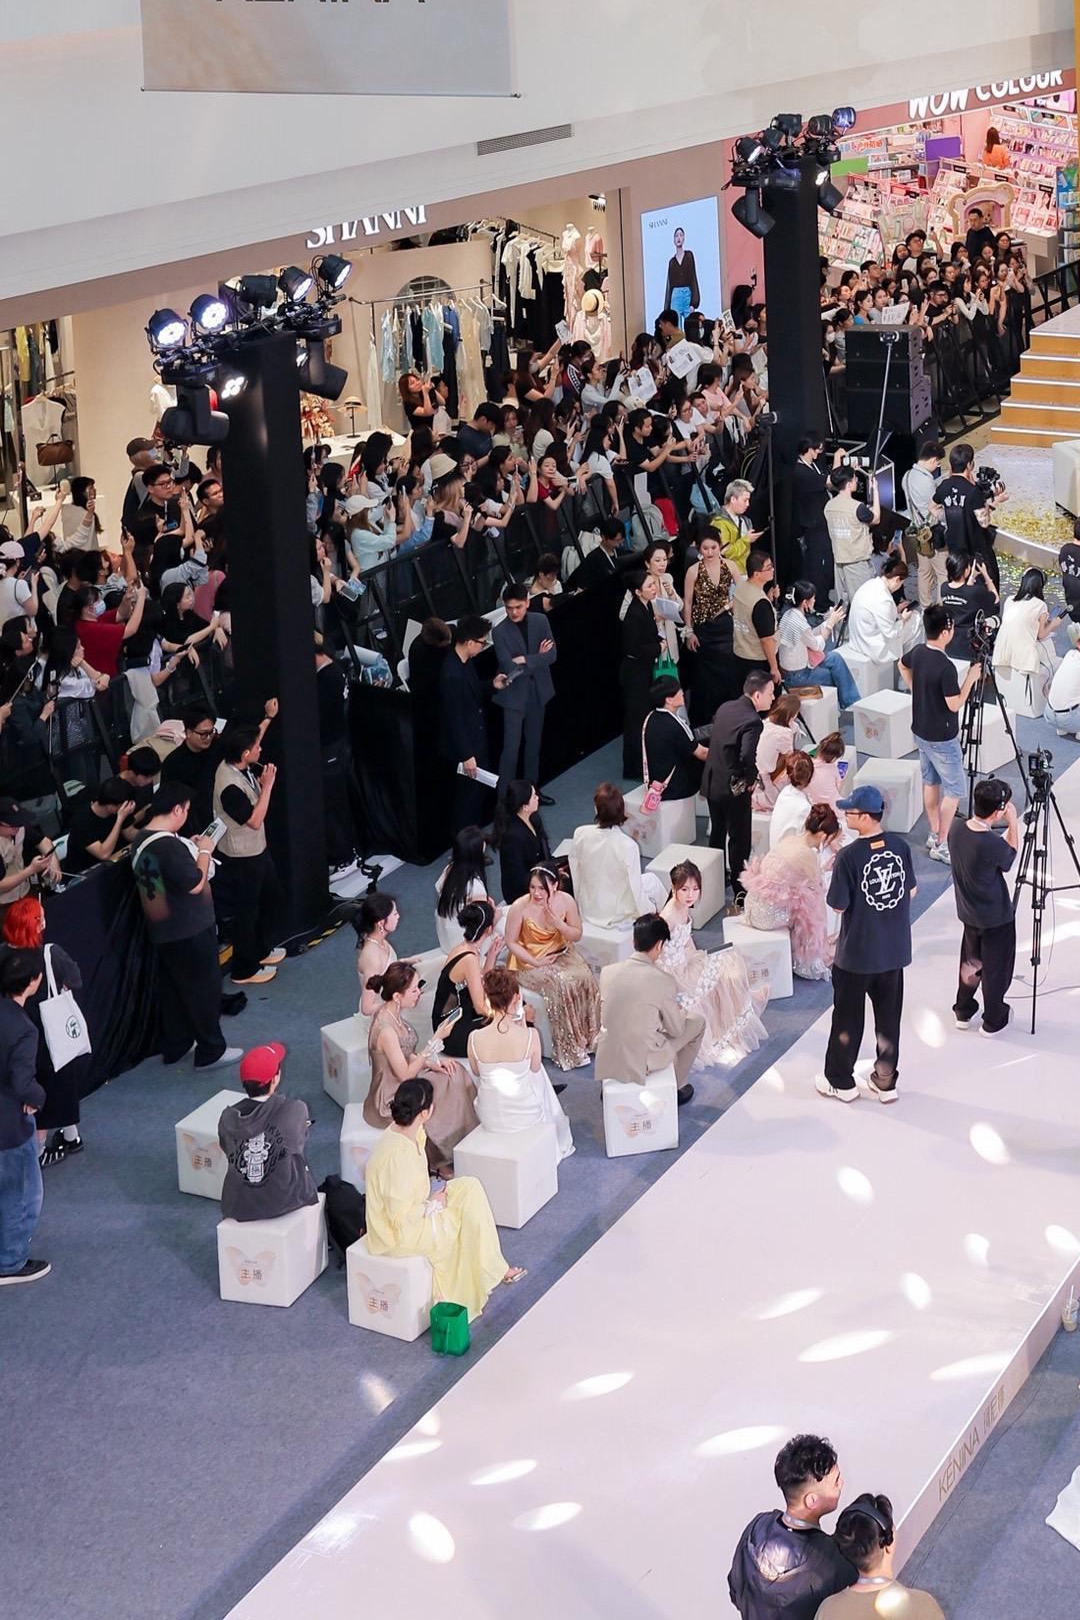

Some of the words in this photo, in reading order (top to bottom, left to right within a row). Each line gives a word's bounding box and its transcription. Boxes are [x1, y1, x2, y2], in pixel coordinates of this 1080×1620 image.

[909, 88, 968, 118] WOW
[975, 69, 1063, 102] COLOUR
[240, 1268, 263, 1280] 主播
[369, 1297, 390, 1312] 主播
